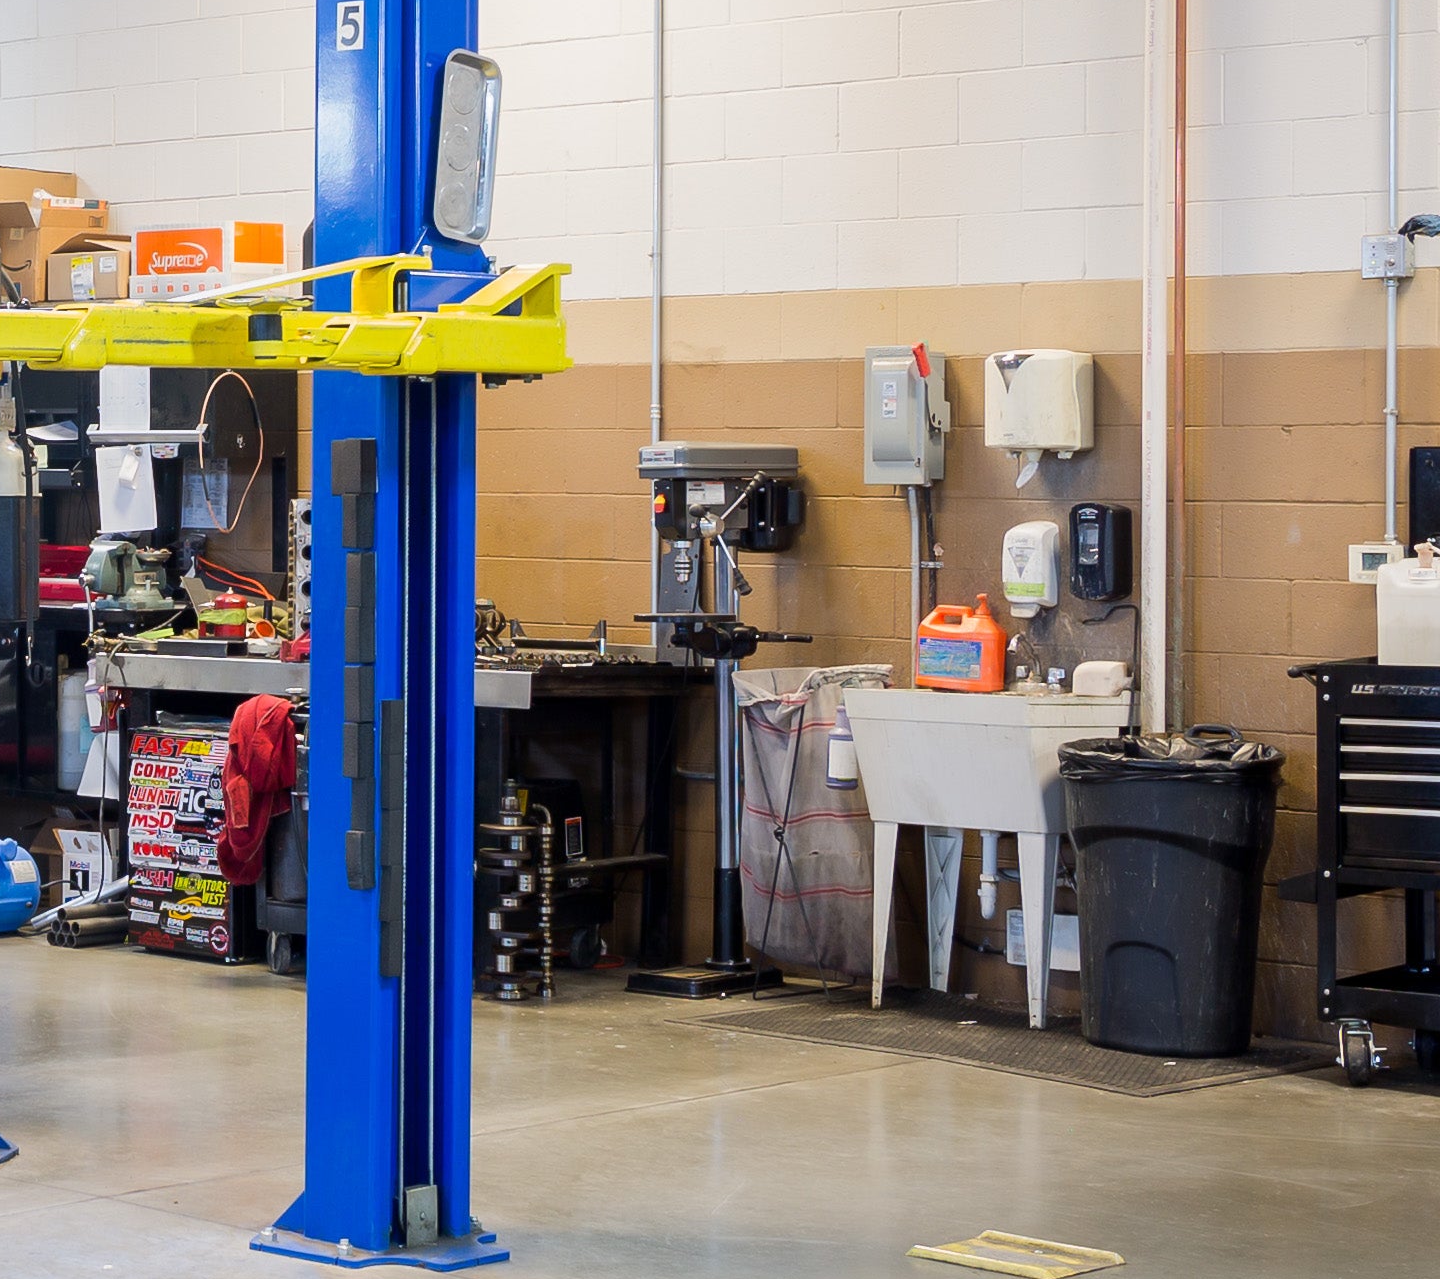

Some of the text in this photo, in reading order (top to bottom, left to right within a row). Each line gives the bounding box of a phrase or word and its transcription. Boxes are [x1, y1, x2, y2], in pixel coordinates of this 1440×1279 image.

[341, 5, 360, 46] 5
[133, 763, 178, 779] COMP
[131, 812, 174, 829] MSD
[69, 860, 90, 869] Mobil
[76, 871, 83, 890] 1
[202, 891, 226, 905] WEST
